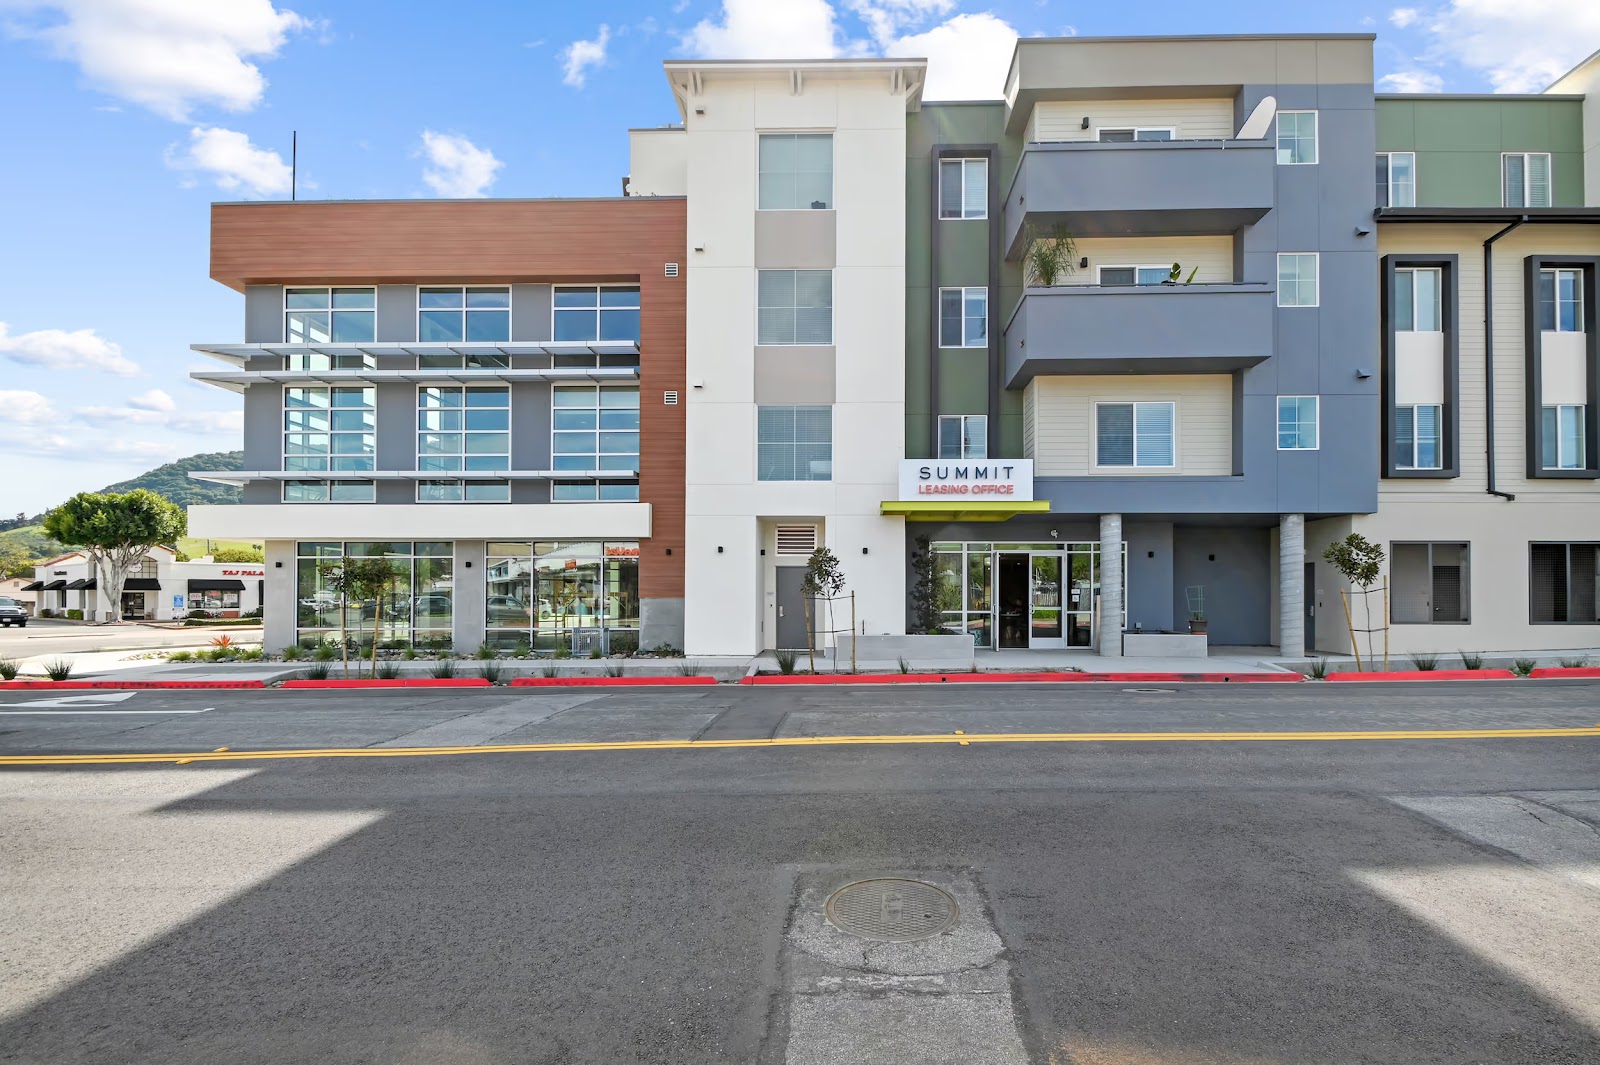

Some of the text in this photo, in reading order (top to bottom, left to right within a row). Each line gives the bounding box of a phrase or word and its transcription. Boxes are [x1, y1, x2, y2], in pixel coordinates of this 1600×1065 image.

[919, 466, 1014, 480] SUMMIT
[918, 484, 1014, 495] LEASING OFFICE
